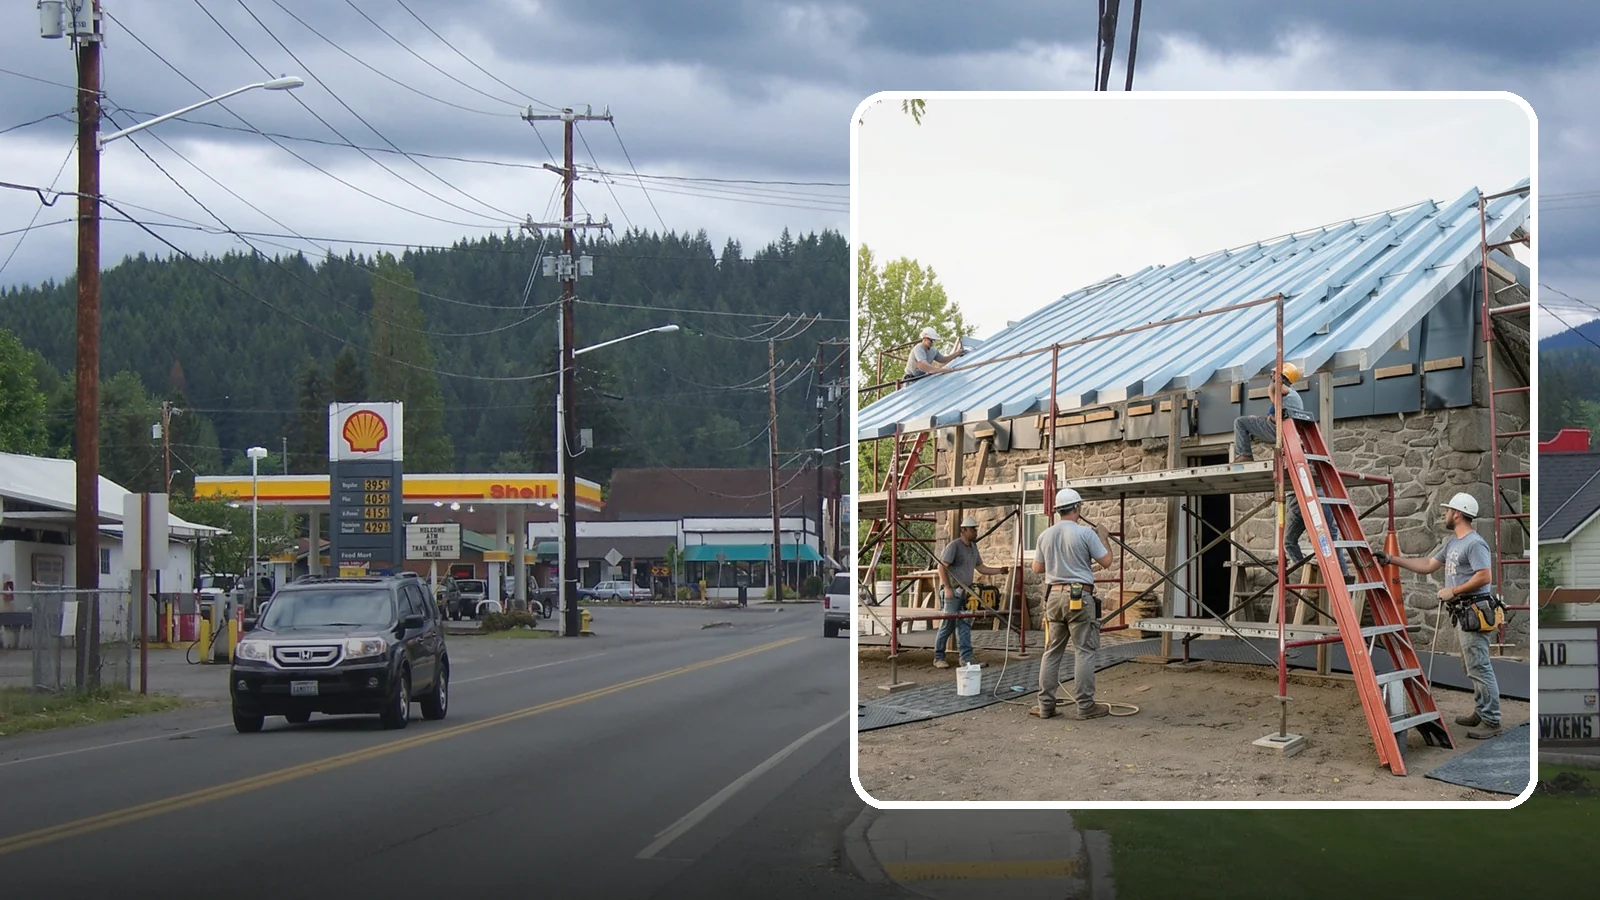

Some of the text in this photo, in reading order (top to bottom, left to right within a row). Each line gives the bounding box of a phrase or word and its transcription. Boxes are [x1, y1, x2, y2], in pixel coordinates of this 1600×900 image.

[366, 480, 384, 490] 395
[490, 484, 547, 499] Shell
[366, 494, 384, 504] 405
[366, 508, 384, 518] 415
[366, 522, 384, 533] 429
[1539, 643, 1567, 666] AID
[1538, 715, 1592, 739] WKENS
